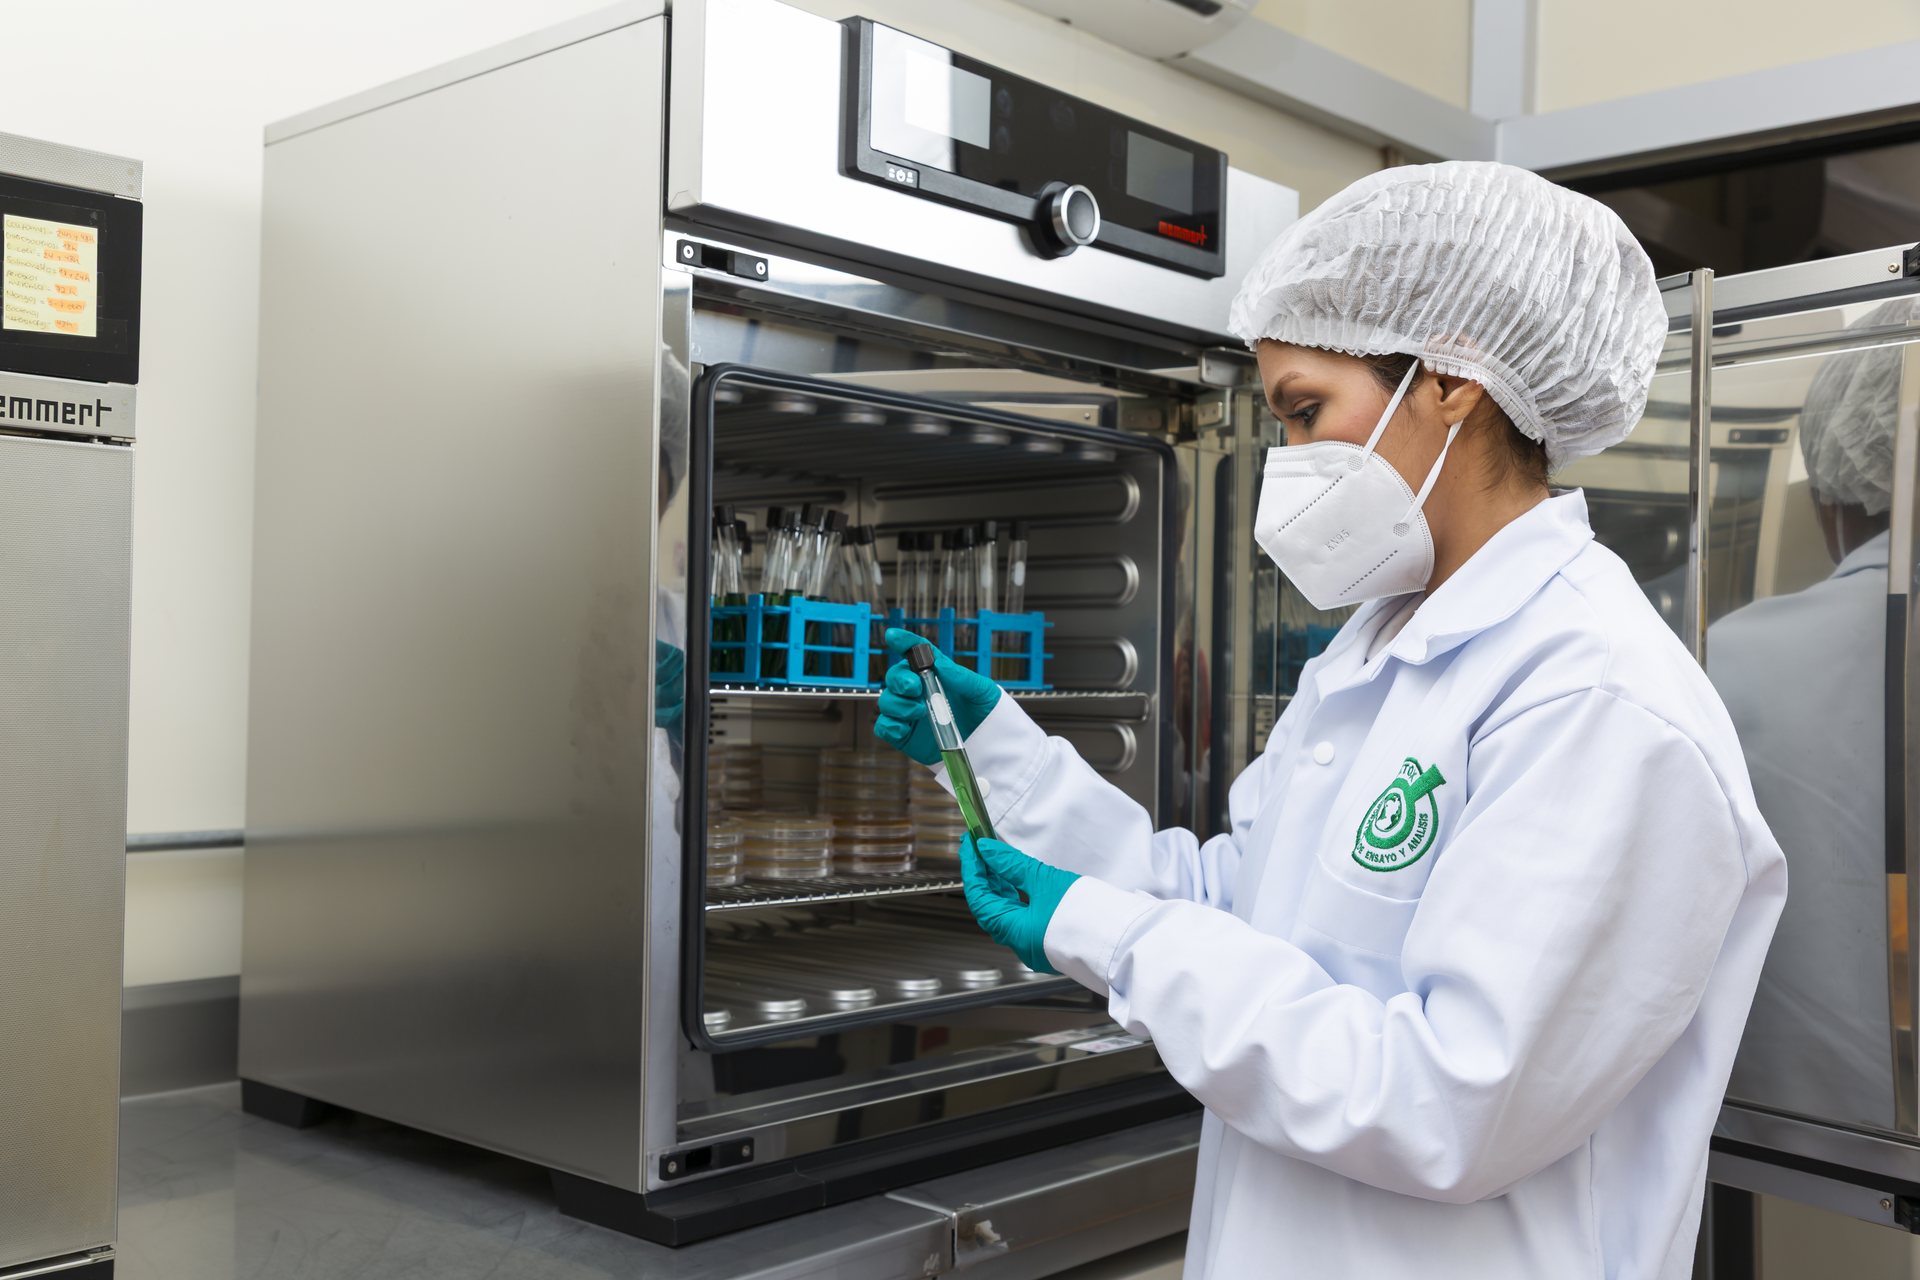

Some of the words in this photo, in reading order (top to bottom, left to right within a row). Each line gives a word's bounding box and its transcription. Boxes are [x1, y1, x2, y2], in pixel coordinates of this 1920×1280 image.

[1159, 221, 1208, 247] memmert
[1325, 528, 1350, 552] KN95
[1365, 851, 1397, 863] ENSAYO
[1398, 848, 1406, 858] Y
[1407, 813, 1428, 852] ANALISIS
